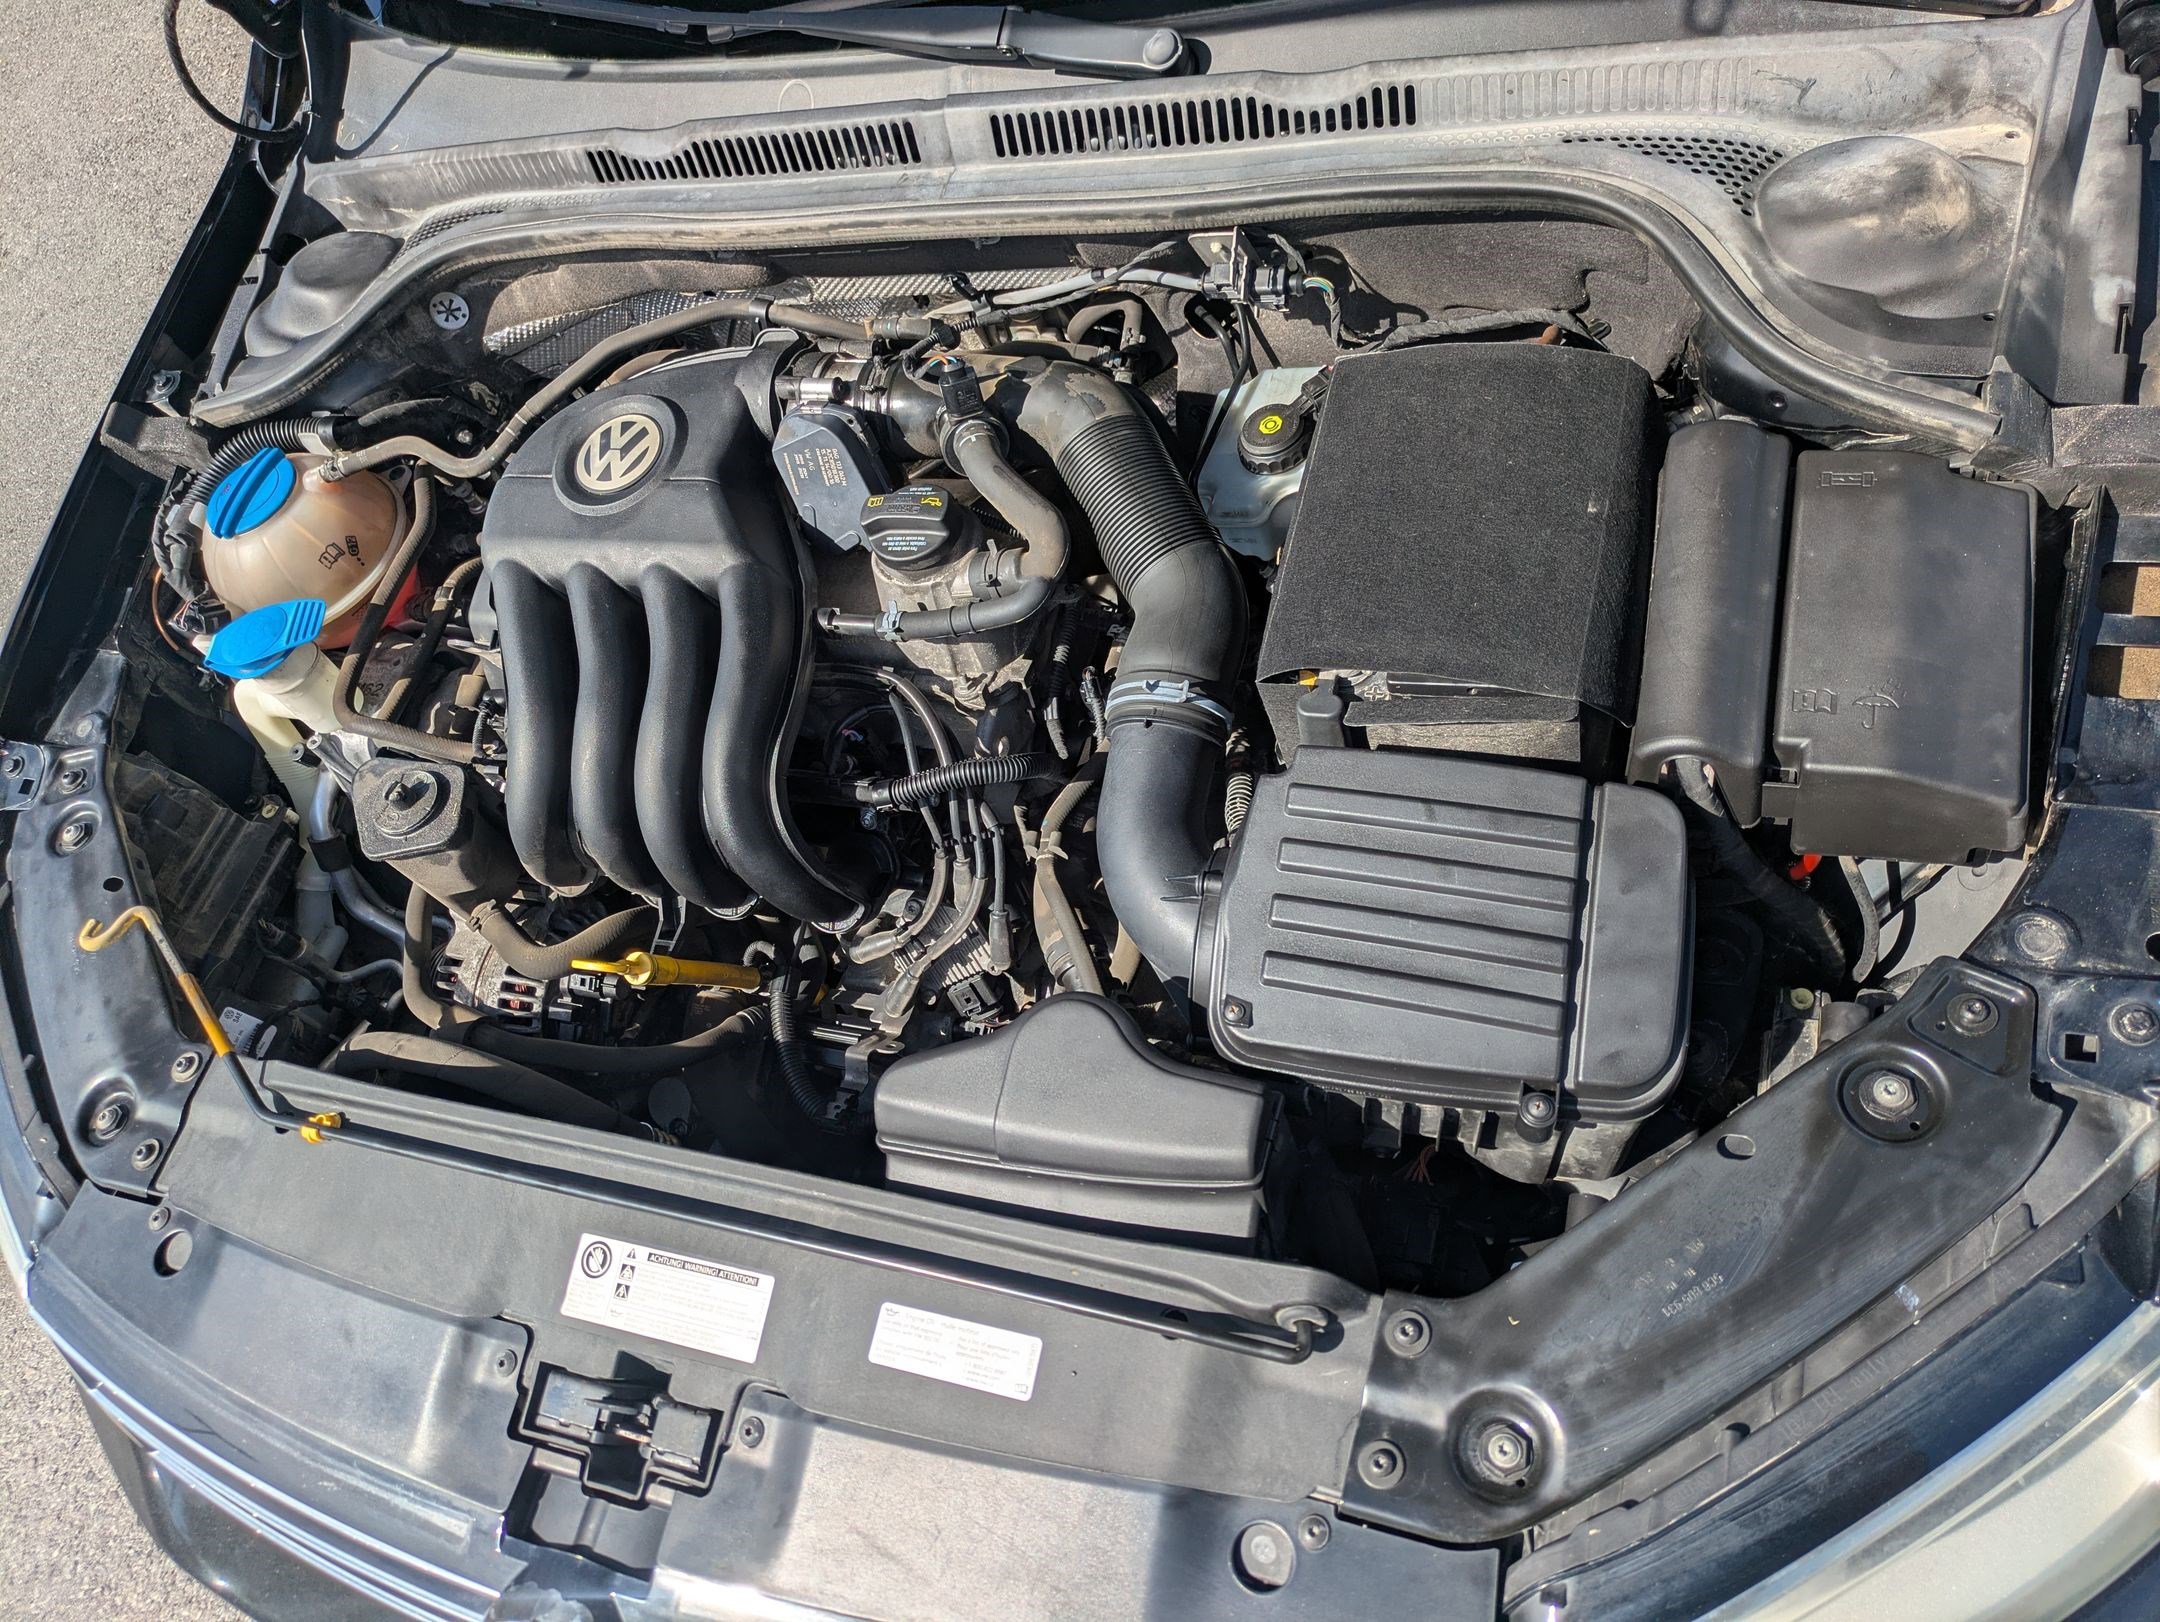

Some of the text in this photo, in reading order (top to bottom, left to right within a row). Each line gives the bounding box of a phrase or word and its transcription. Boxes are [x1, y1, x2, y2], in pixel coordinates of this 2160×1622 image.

[578, 416, 658, 488] VW
[804, 448, 816, 471] VW AG
[232, 1012, 243, 1024] SAE
[649, 1254, 758, 1286] ACHTUNG! WARNING! ATTENTION!
